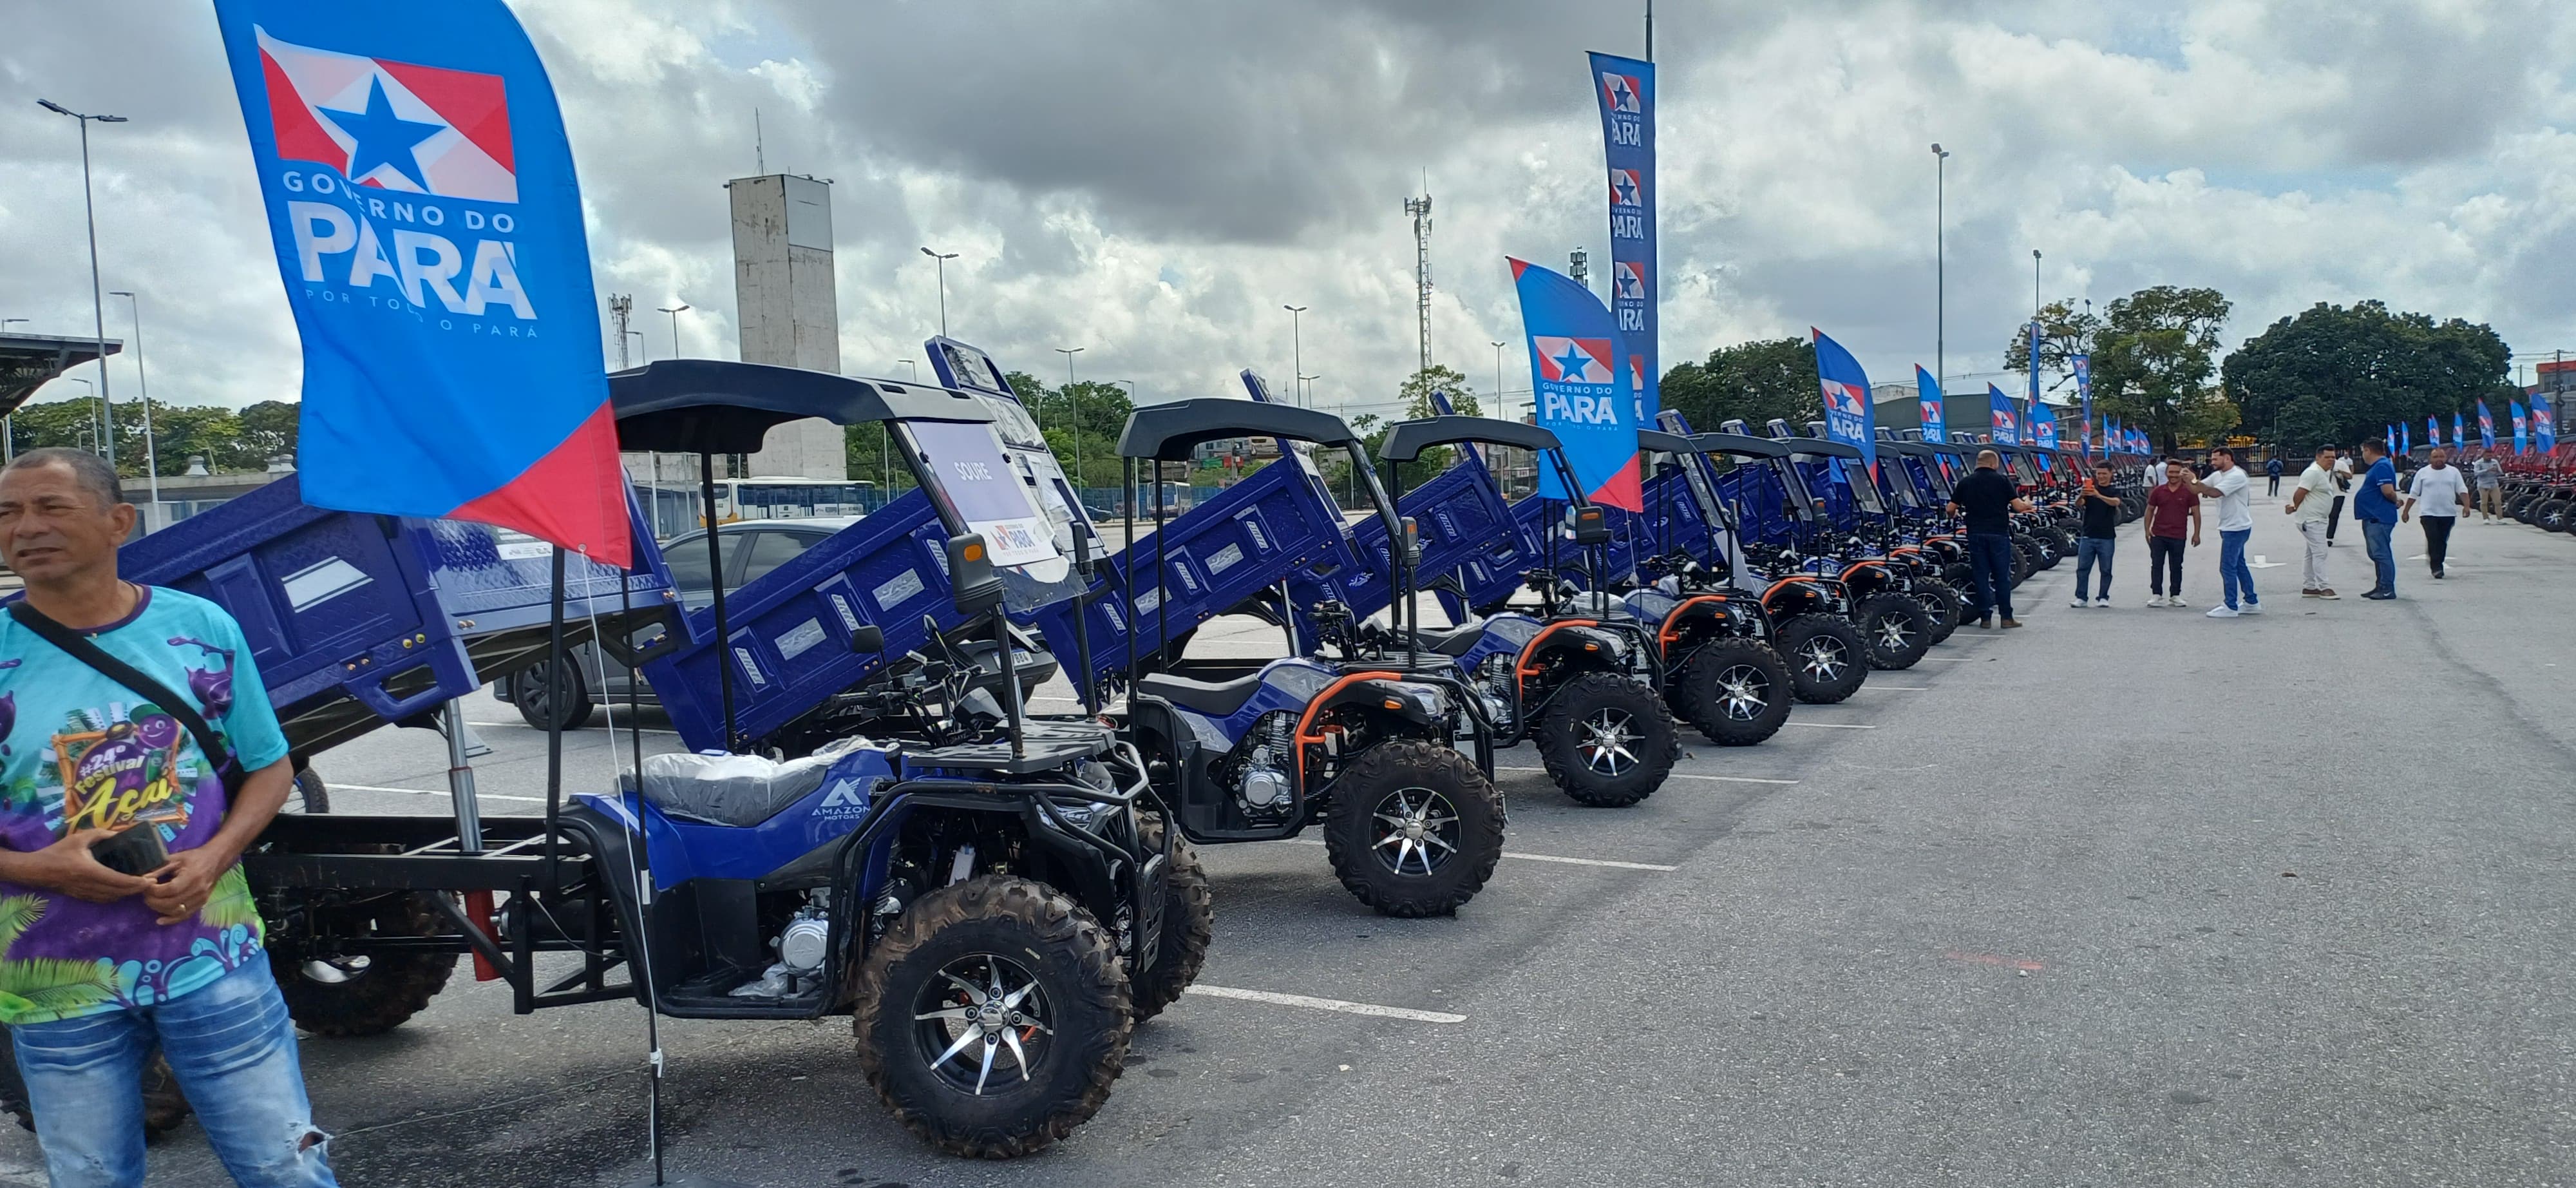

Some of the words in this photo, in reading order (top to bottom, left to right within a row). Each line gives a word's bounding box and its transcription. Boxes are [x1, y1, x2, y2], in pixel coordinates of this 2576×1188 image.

[465, 210, 515, 233] DO
[306, 289, 350, 304] POR
[440, 320, 452, 331] O
[473, 323, 538, 338] PARÁ
[954, 462, 993, 481] SOURE
[75, 755, 146, 794] Festival
[811, 805, 871, 816] AMAZON
